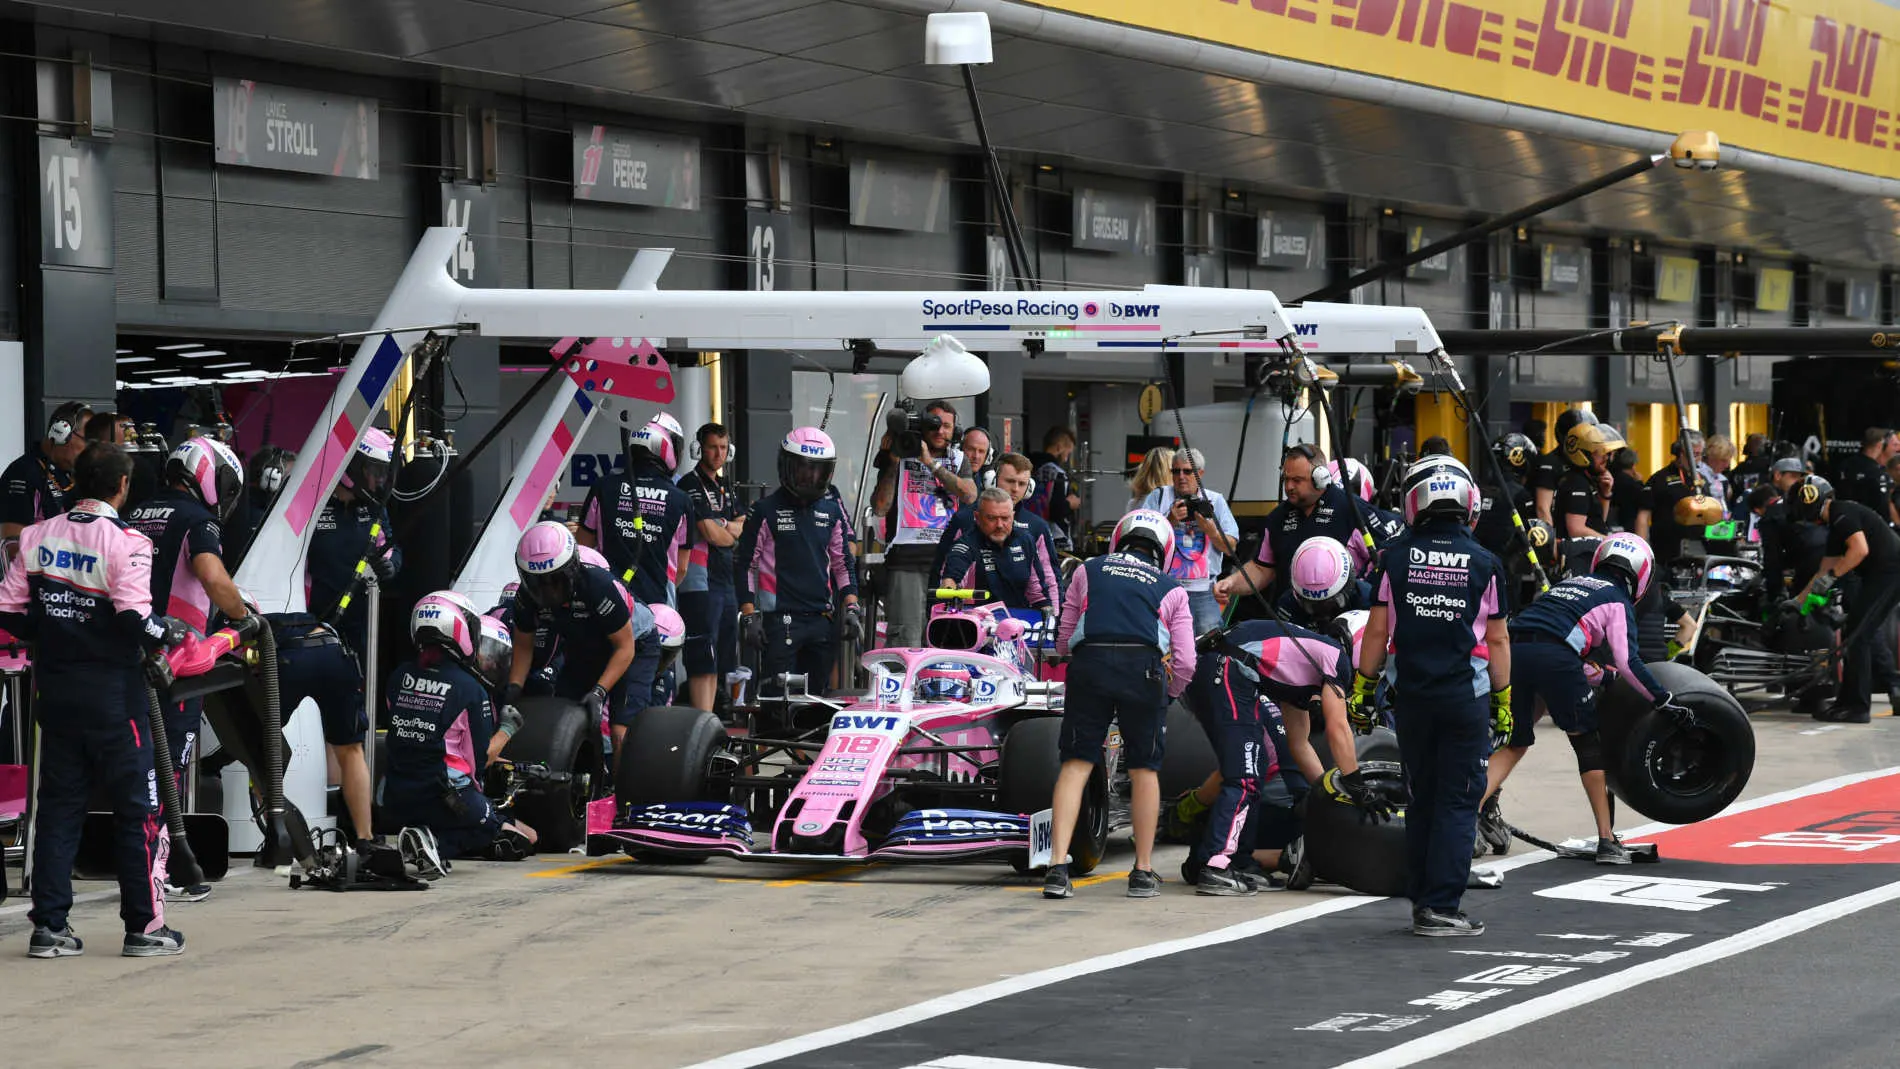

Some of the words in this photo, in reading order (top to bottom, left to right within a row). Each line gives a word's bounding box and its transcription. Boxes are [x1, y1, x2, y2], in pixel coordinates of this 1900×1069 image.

[266, 118, 318, 157] STROLL
[613, 159, 648, 190] PEREZ
[47, 156, 83, 251] 15
[446, 199, 475, 280] 14
[751, 225, 775, 292] 13
[922, 299, 1014, 320] SportPesa
[1016, 299, 1079, 321] Racing
[1124, 304, 1161, 319] BWT
[1294, 324, 1318, 336] WT
[358, 442, 374, 453] WT
[800, 444, 826, 456] BWT
[635, 487, 668, 501] BWT
[1430, 480, 1456, 492] BWT
[142, 507, 175, 520] BWT
[1613, 541, 1637, 553] BWT
[55, 549, 97, 574] BWT
[528, 558, 555, 571] BWT
[1428, 551, 1471, 569] BWT
[1408, 569, 1469, 582] MAGNESIUM
[38, 588, 96, 608] SportPesa
[1406, 592, 1466, 610] SportPesa
[46, 603, 86, 622] Racing
[418, 609, 441, 619] BWT
[1416, 606, 1454, 621] Racing
[413, 678, 452, 697] BWT
[396, 695, 444, 709] MAGNESIUM
[833, 715, 900, 731] BWT
[835, 735, 880, 754] 18
[819, 765, 866, 773] NEC
[922, 809, 1021, 837] Pesa
